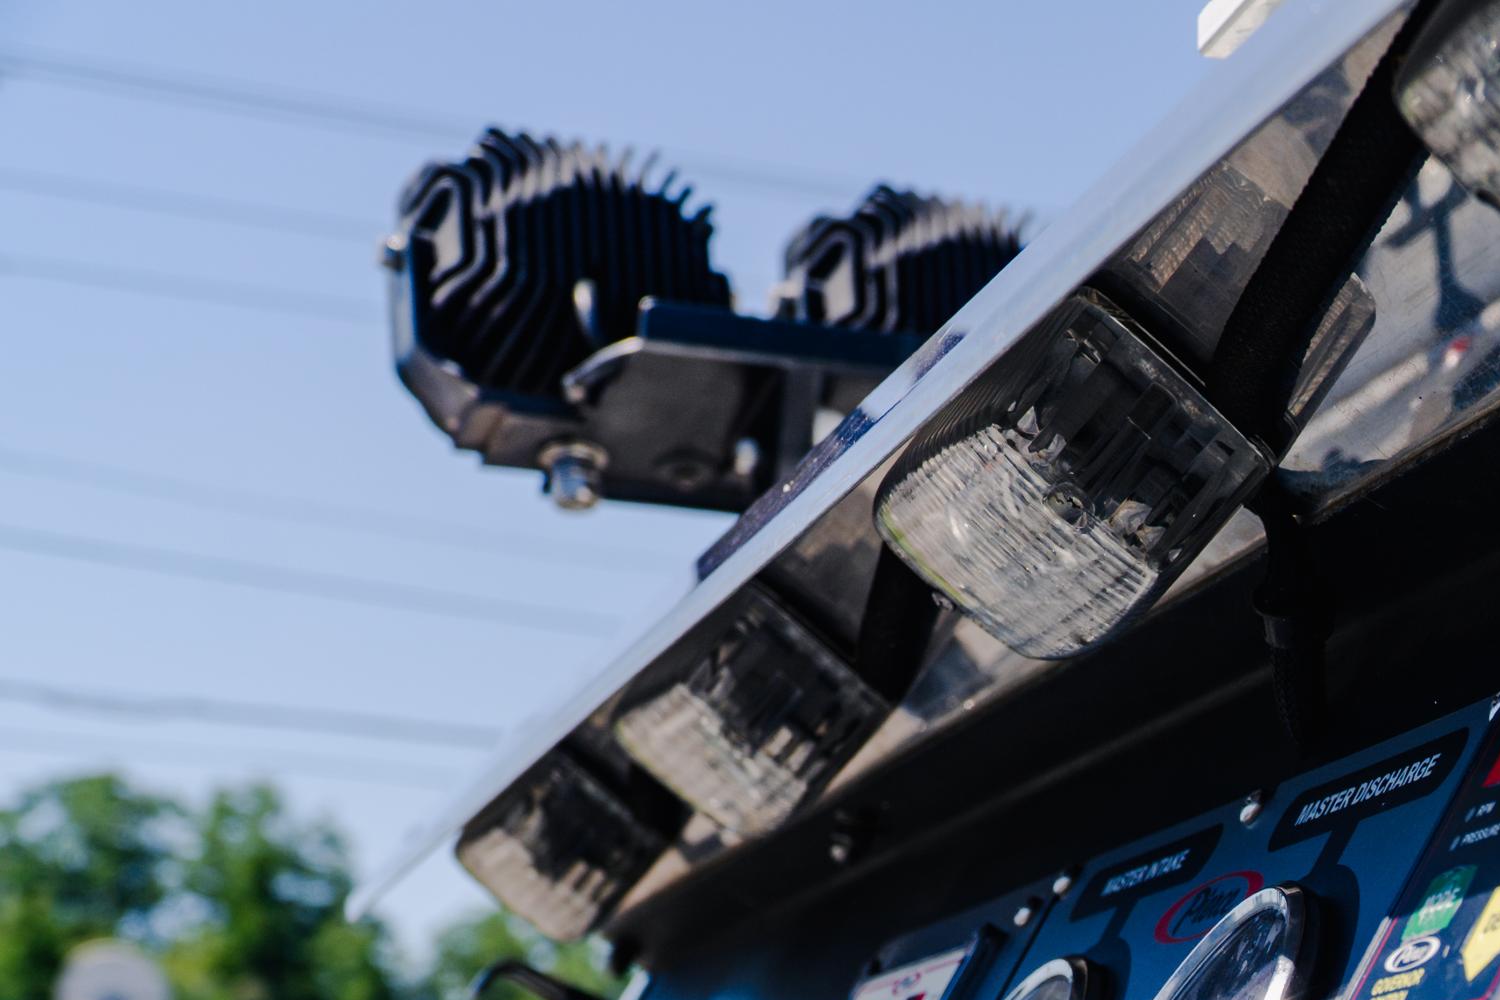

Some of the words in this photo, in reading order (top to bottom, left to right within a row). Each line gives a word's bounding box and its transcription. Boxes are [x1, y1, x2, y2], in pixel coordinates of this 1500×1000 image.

[1295, 785, 1356, 826] MASTER
[1350, 753, 1441, 805] DISCHARGE
[1101, 866, 1147, 897] MASTER
[1144, 849, 1191, 882] INTAKE
[1371, 967, 1426, 996] GOVERNOR
